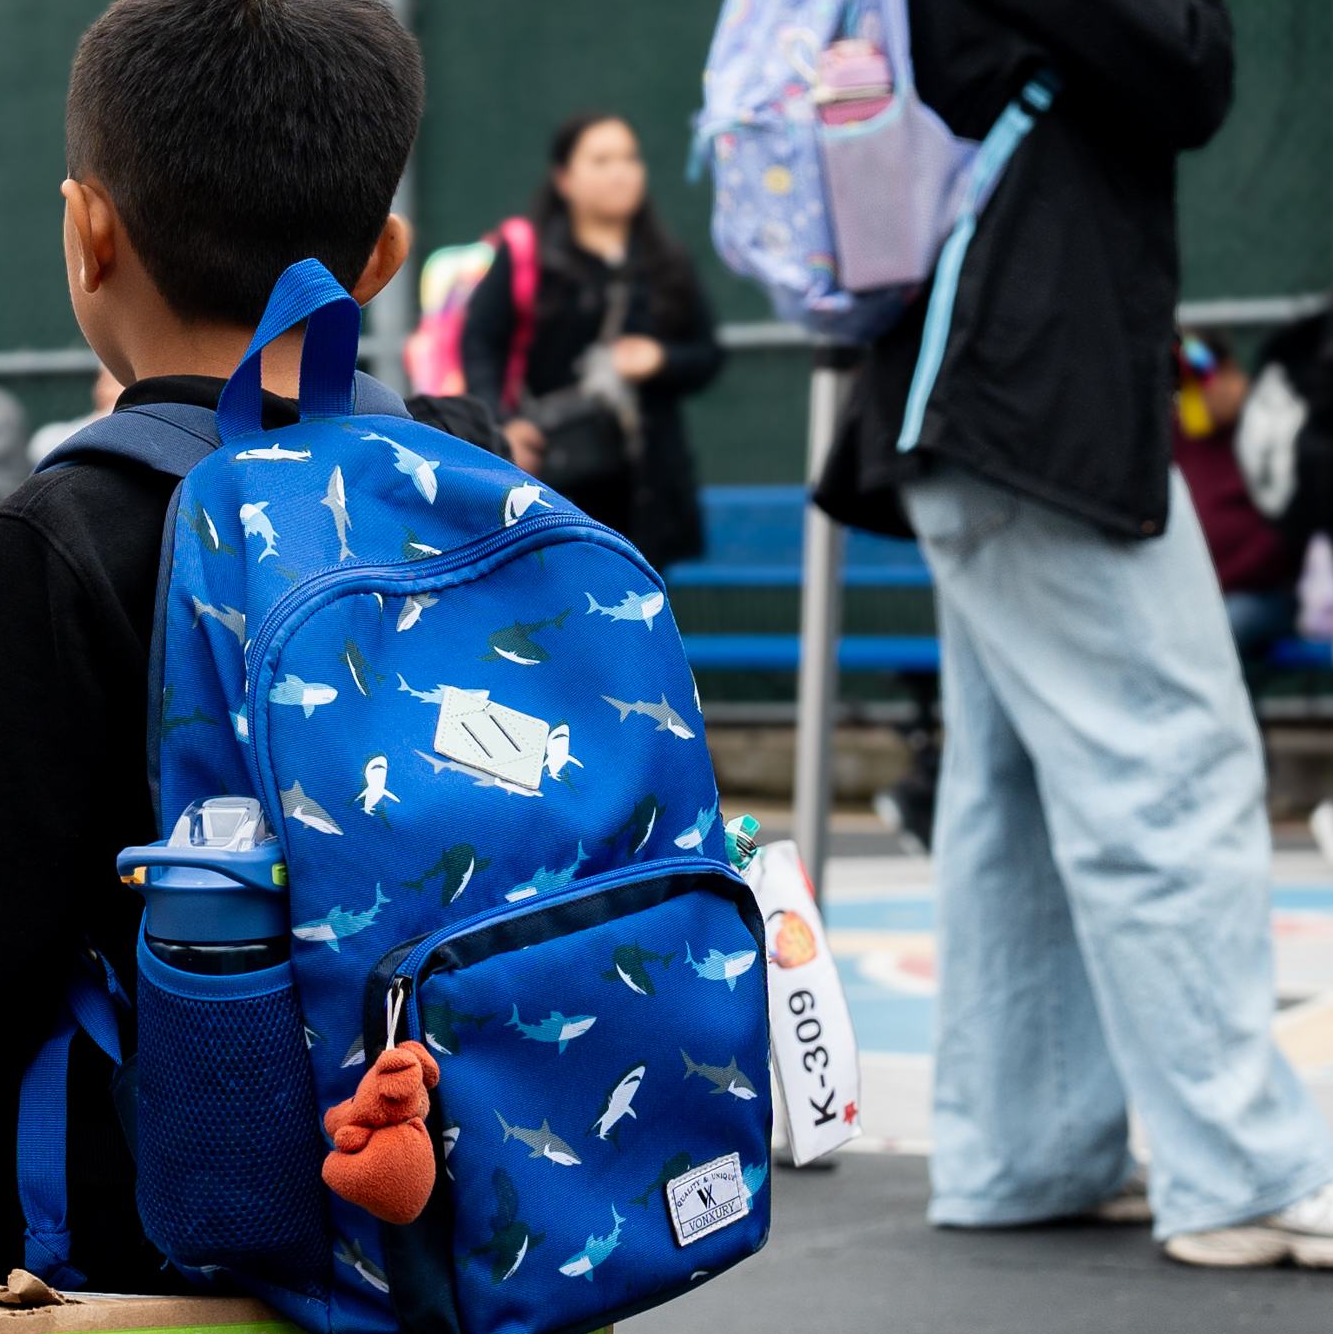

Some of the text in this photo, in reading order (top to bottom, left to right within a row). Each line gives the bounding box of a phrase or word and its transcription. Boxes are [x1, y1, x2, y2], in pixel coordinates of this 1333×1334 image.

[788, 989, 837, 1127] K-309
[676, 1179, 701, 1208] QUALITY
[711, 1172, 737, 1182] UNIQUE
[689, 1201, 735, 1231] VONXURY
